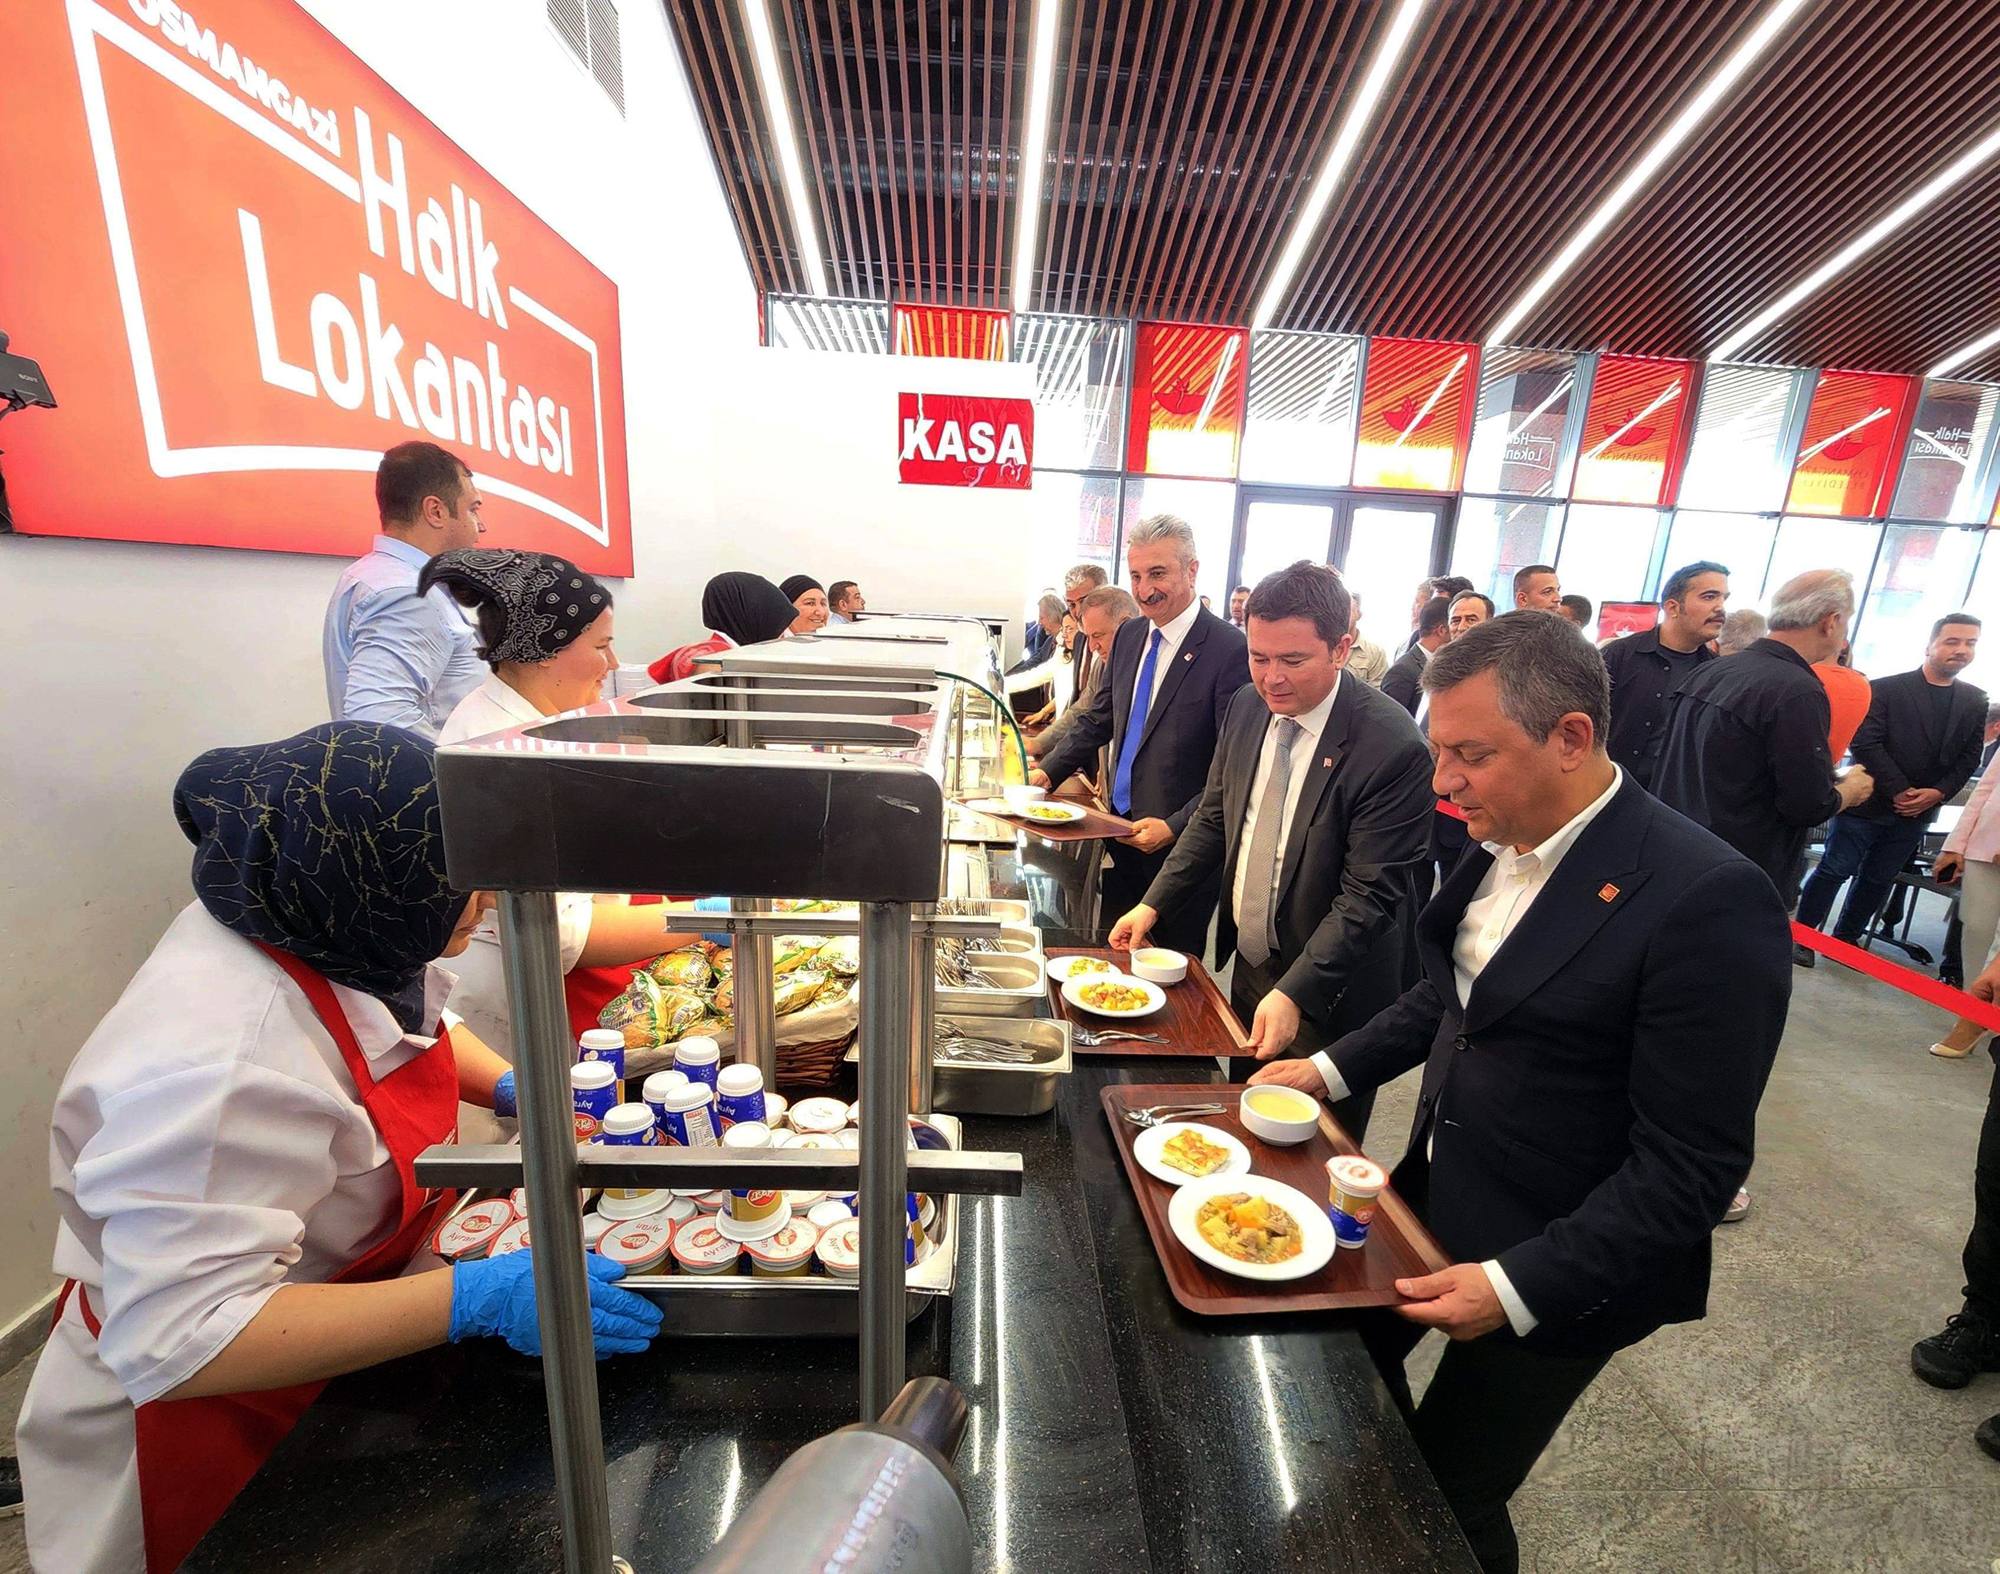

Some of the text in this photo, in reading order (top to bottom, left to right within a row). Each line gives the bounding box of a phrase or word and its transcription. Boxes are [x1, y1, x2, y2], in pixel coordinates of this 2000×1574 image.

[354, 106, 509, 330] Halk
[237, 207, 574, 476] Lokantası
[902, 417, 1028, 466] KASA
[446, 1231, 477, 1243] Ayran
[636, 1222, 662, 1233] Ayran
